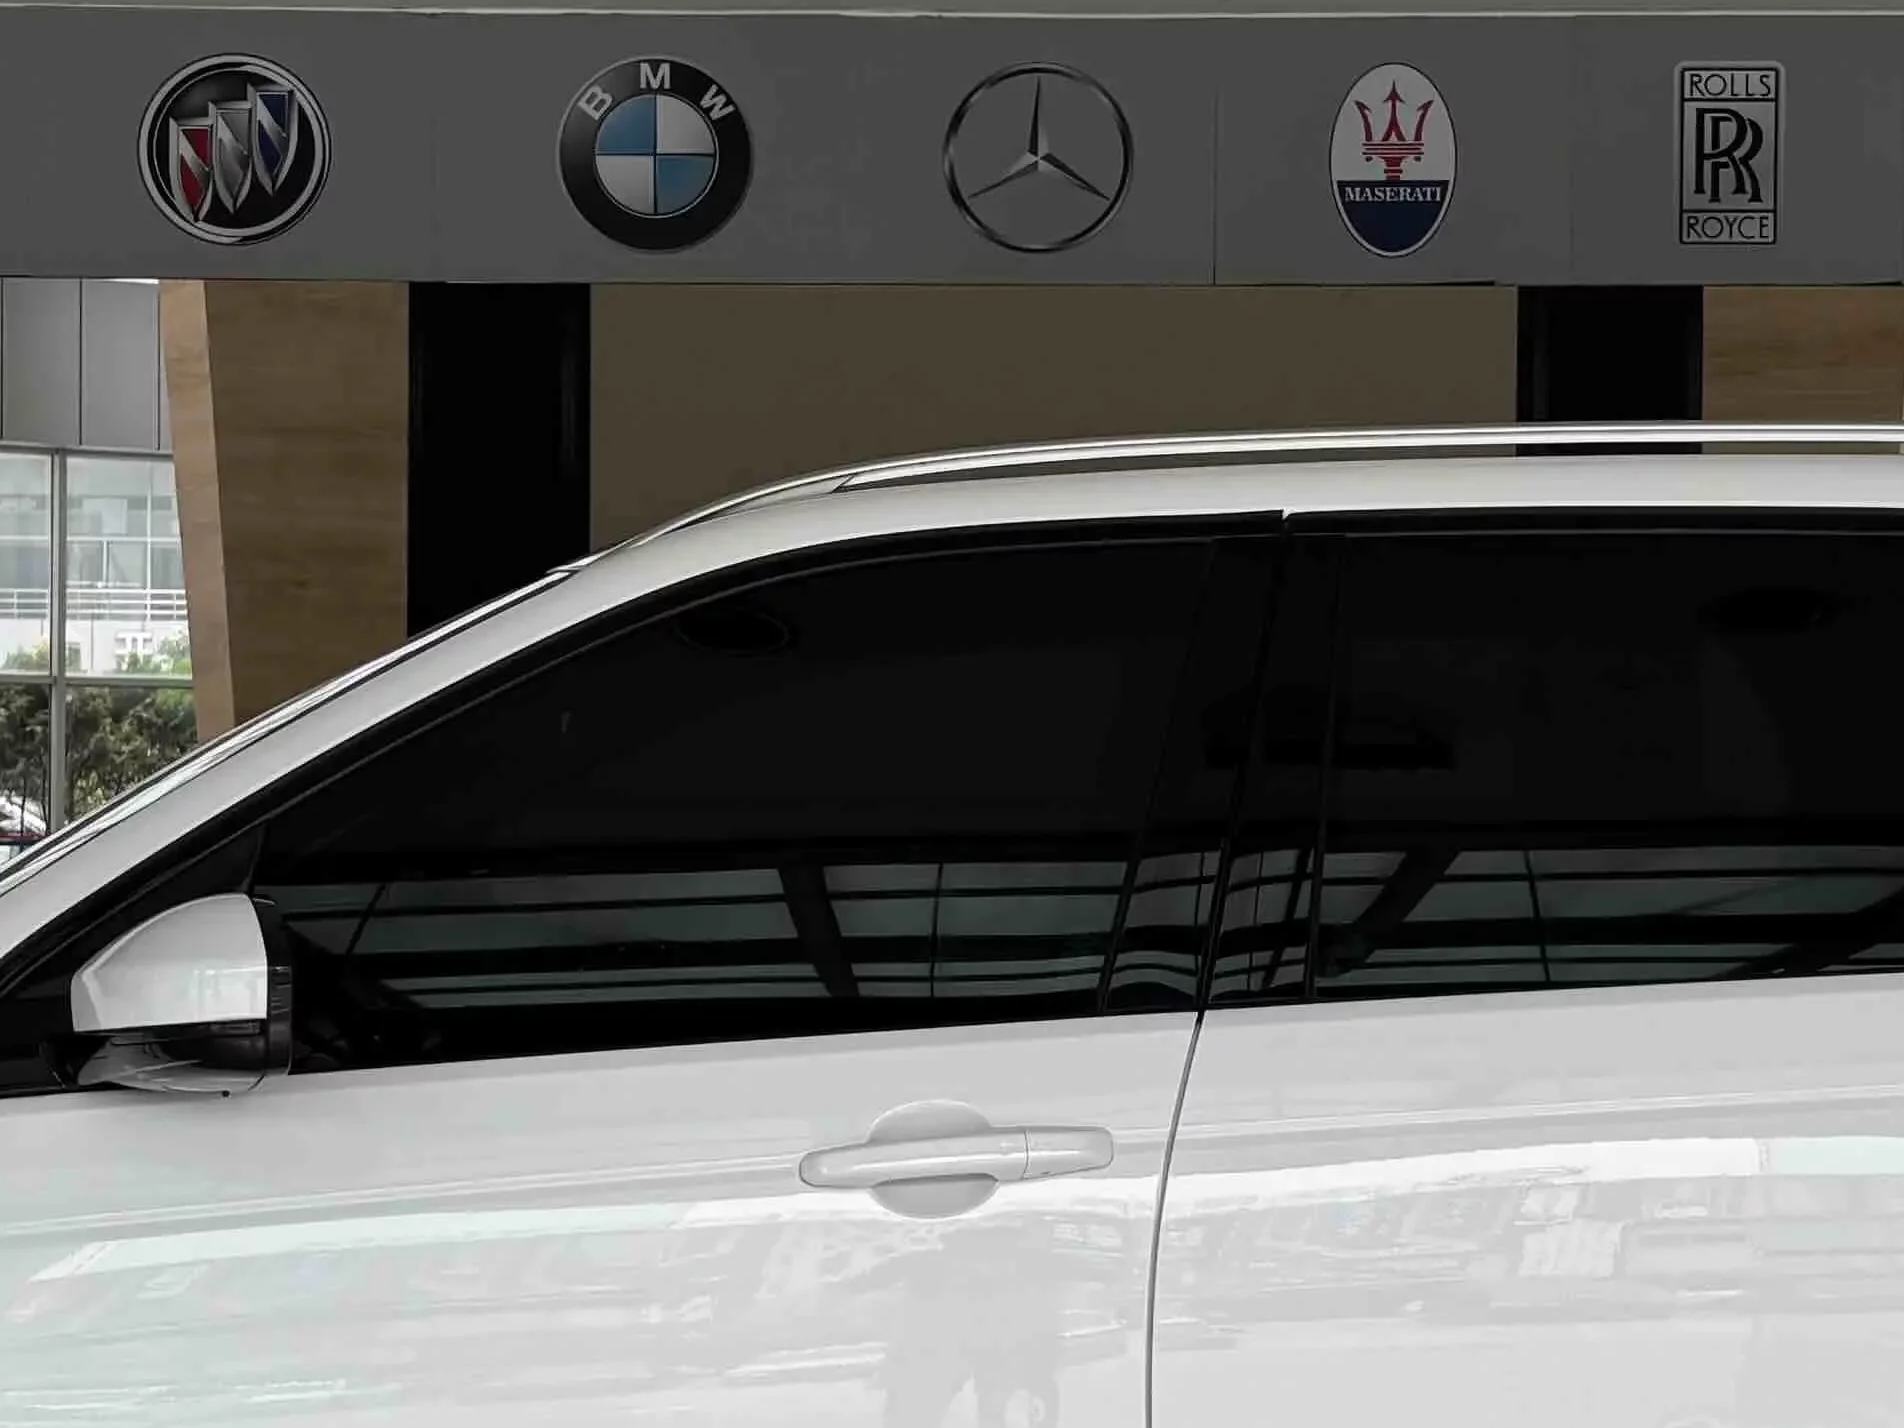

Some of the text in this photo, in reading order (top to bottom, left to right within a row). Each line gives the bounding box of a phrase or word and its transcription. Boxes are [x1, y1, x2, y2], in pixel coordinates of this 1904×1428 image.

[576, 61, 737, 122] BMW
[1688, 73, 1772, 98] ROLLS
[1344, 183, 1444, 205] MASERATI
[1686, 214, 1771, 241] ROYCE
